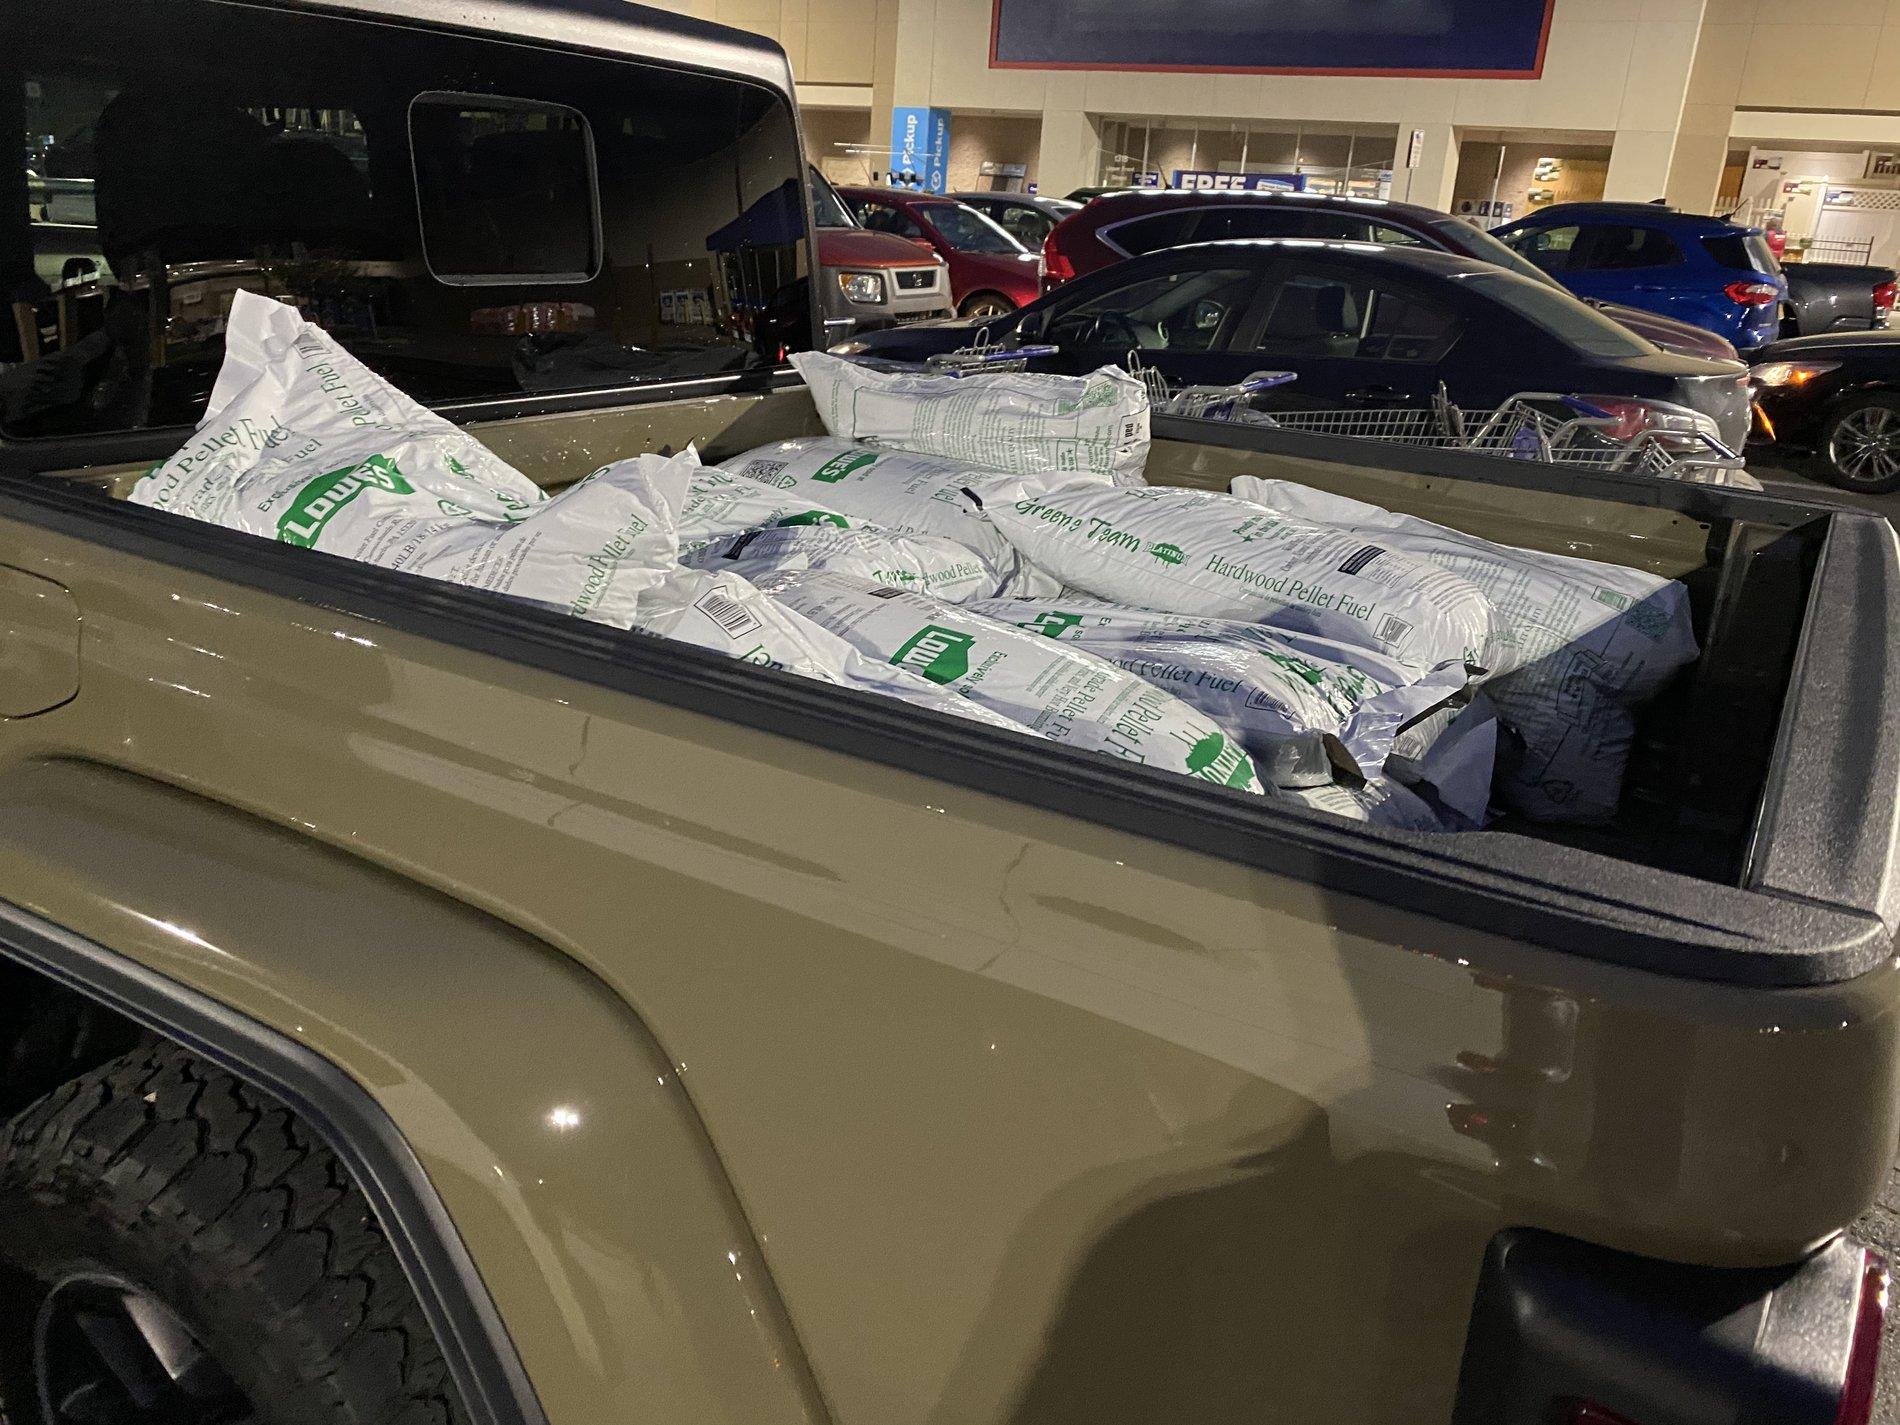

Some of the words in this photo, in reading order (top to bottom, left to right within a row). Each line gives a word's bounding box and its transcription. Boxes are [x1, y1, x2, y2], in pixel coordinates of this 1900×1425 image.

[902, 114, 918, 164] Pickup
[1087, 517, 1142, 553] Team
[1205, 553, 1288, 594] Hardwood
[1286, 580, 1337, 608] Pellet
[1334, 593, 1377, 622] Fuel
[1193, 671, 1243, 694] Fuel
[1058, 690, 1096, 723] Pellet
[1112, 701, 1166, 746] Pellet
